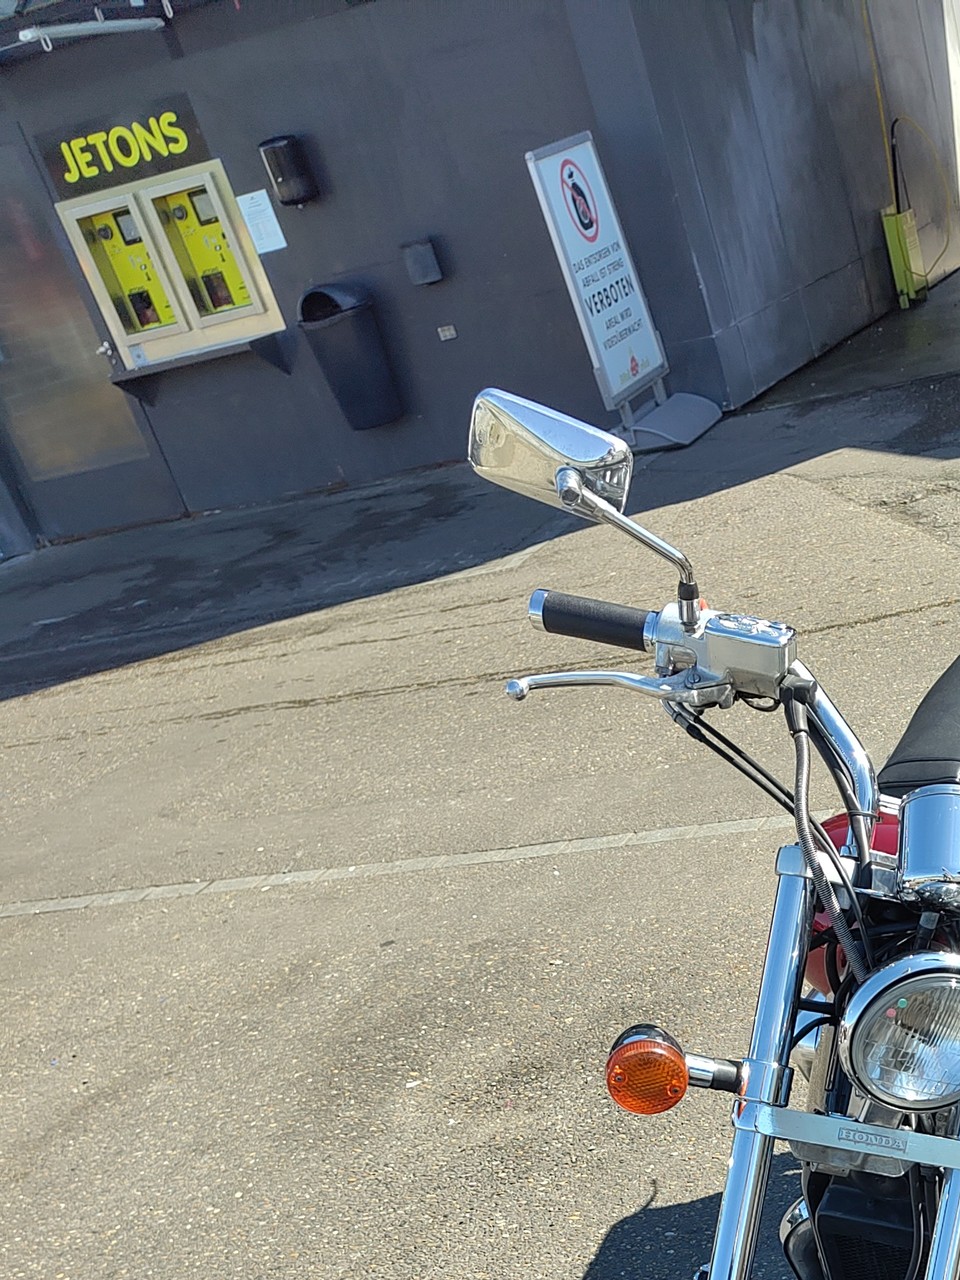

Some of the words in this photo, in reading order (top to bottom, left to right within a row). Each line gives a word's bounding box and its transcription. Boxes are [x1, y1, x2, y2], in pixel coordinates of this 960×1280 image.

[60, 111, 188, 183] JETONS
[584, 246, 611, 268] ENTSORGEN
[582, 271, 601, 287] ABFALL
[606, 258, 625, 275] STRENG
[584, 274, 635, 317] VERBOTEN
[605, 314, 621, 330] AREAL
[619, 307, 632, 321] WIRD
[840, 1129, 905, 1150] HONDA
